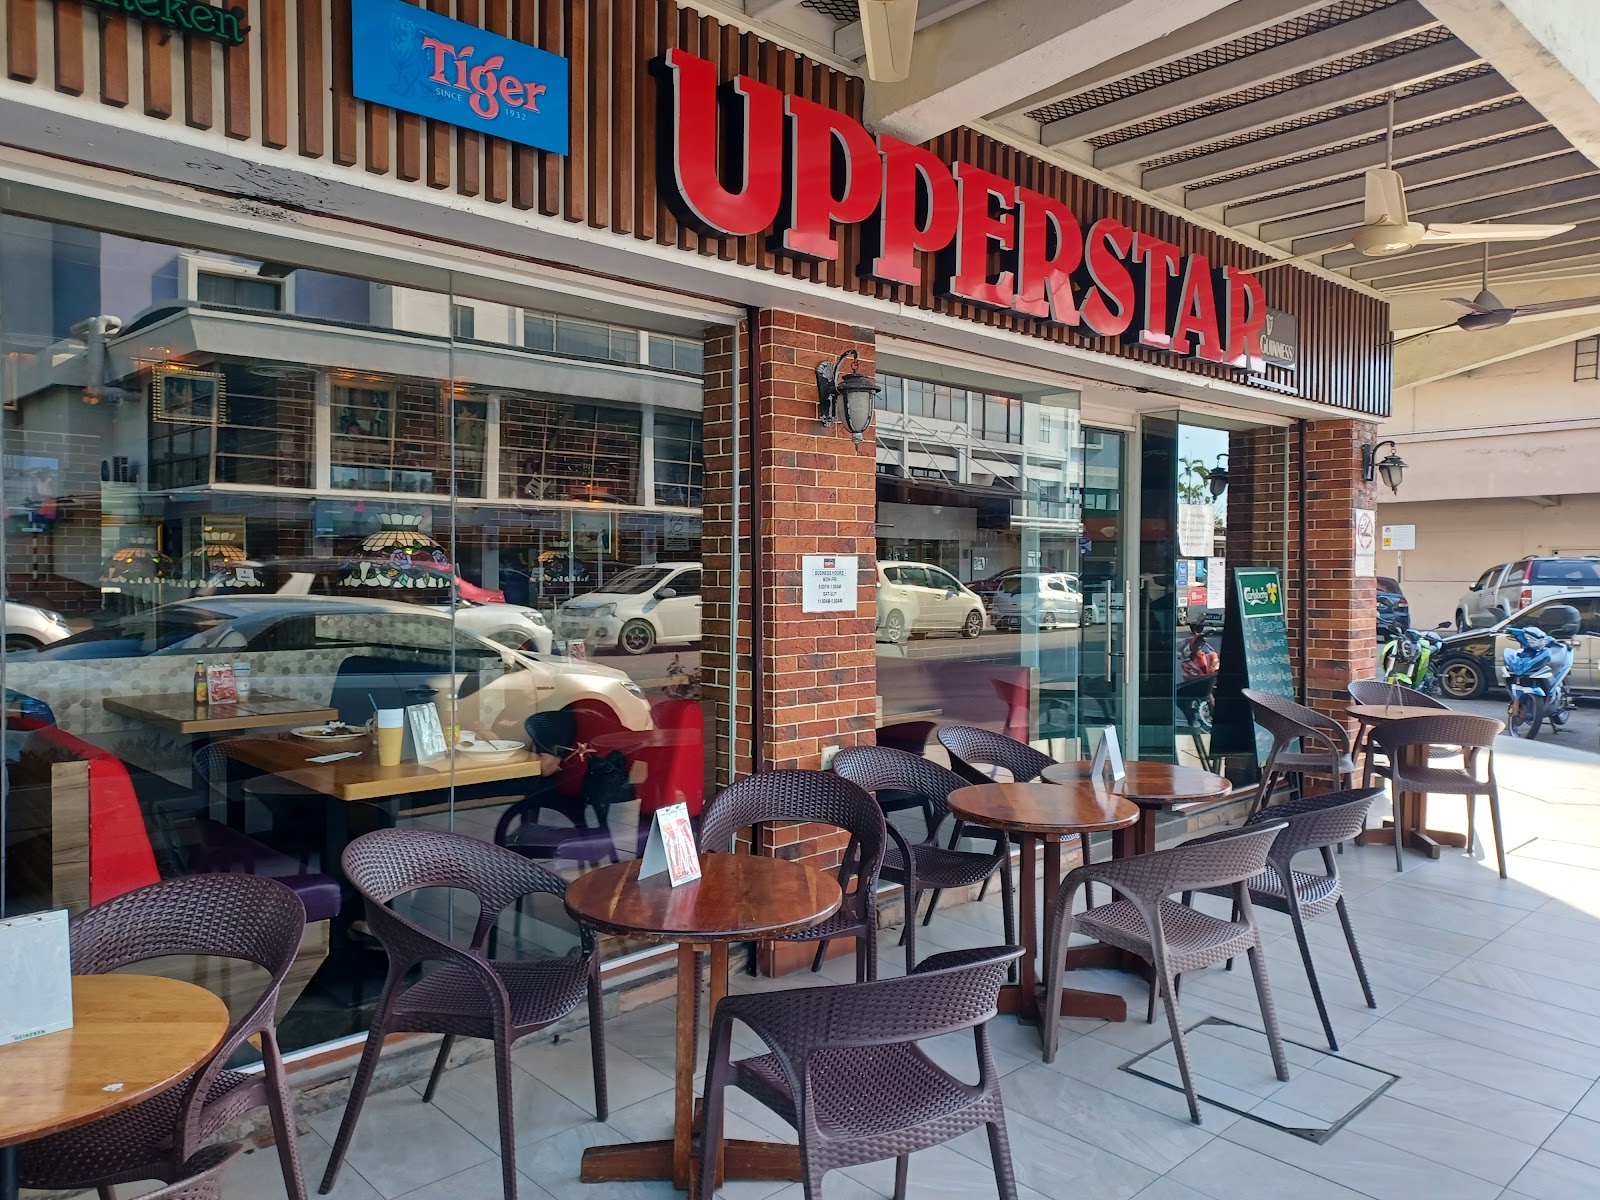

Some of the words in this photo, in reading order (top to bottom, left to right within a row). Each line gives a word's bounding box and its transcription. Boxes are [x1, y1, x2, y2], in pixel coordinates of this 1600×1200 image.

[422, 36, 546, 119] Tiger
[435, 87, 463, 102] SINCE
[504, 108, 526, 121] 1932
[656, 47, 1267, 373] UPPERSTAR
[1260, 334, 1293, 361] GUINNESS
